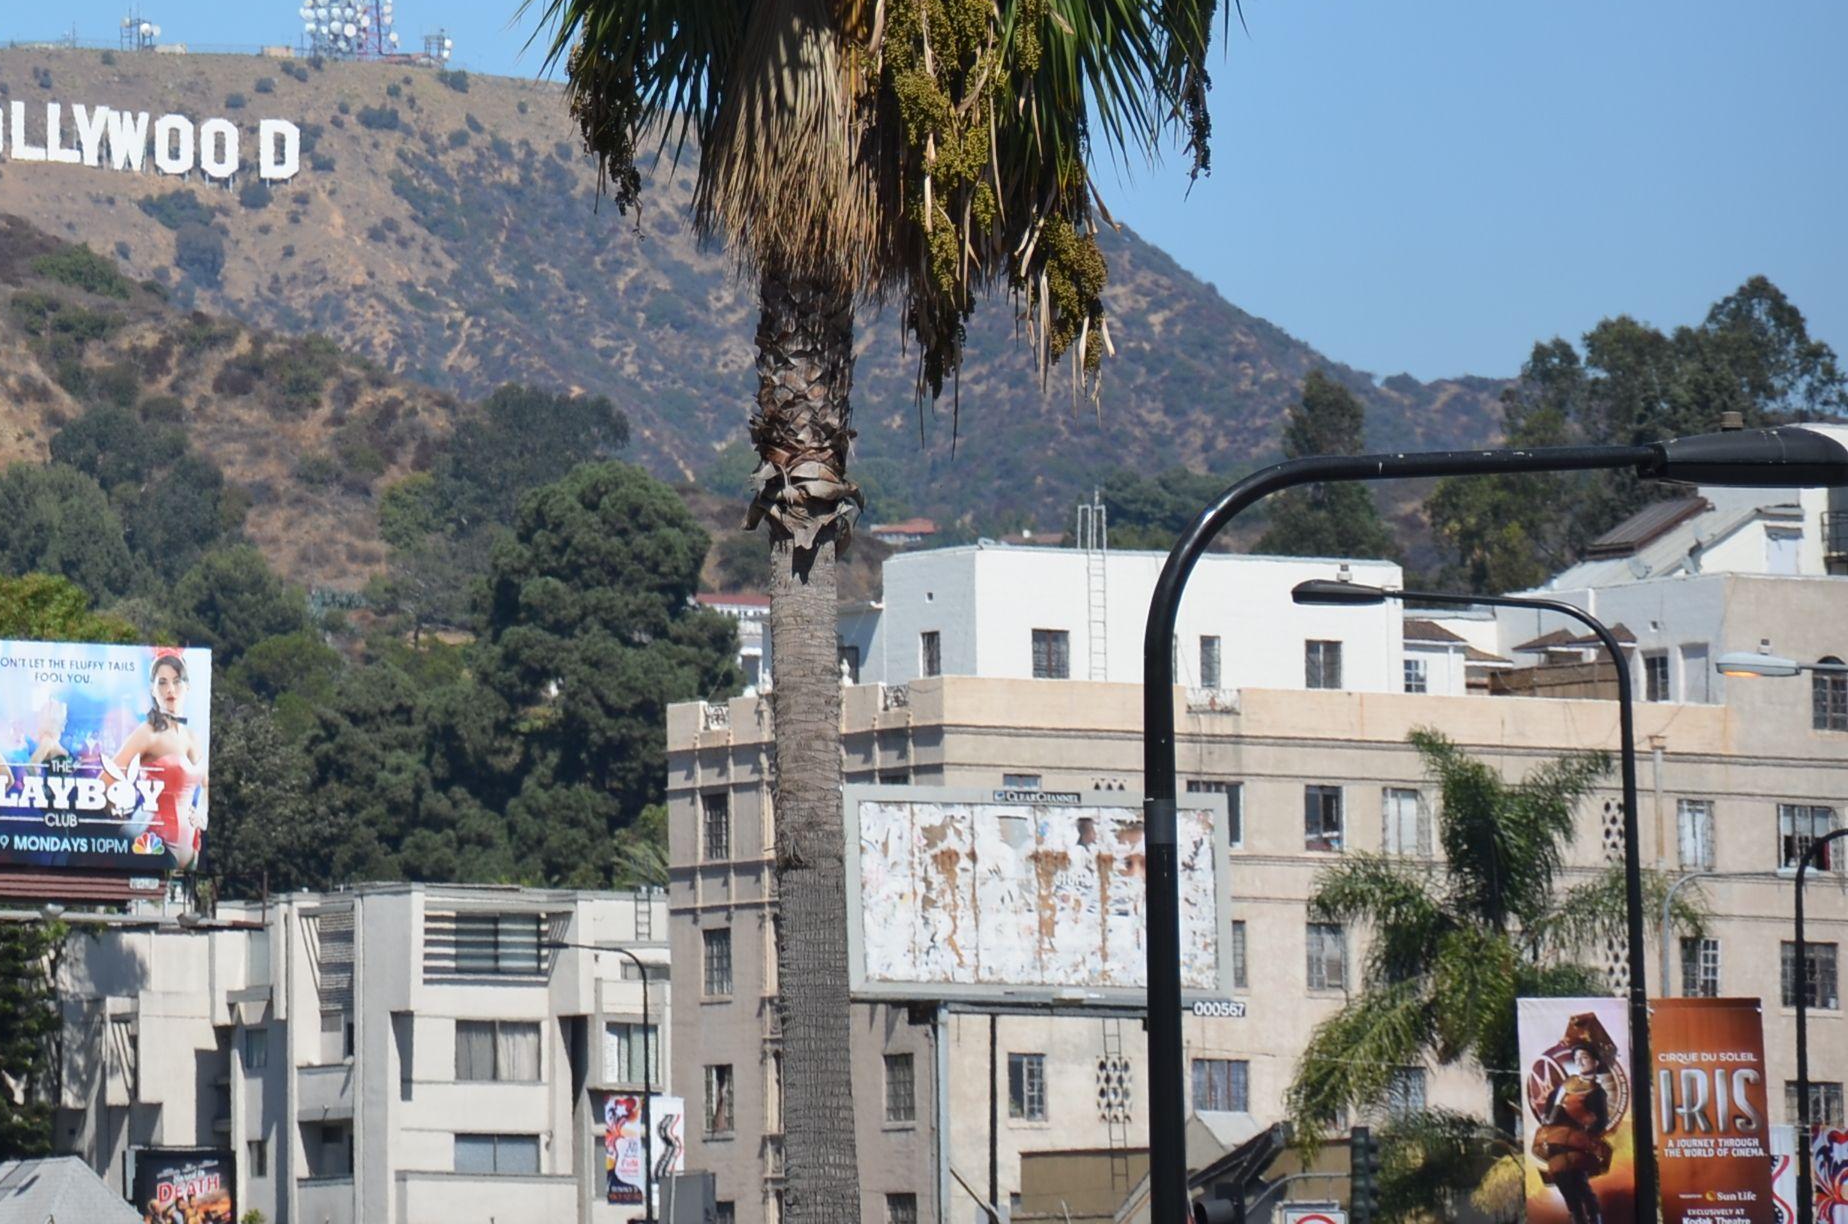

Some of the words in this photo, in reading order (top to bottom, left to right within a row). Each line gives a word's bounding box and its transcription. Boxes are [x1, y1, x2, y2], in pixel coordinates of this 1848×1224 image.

[29, 658, 45, 669] LET
[48, 658, 65, 669] THE
[69, 660, 104, 670] FLUFFY
[108, 661, 135, 671] TAILS
[34, 672, 63, 683] FOOL
[51, 760, 72, 773] THE
[44, 814, 78, 827] CLUB
[13, 836, 89, 853] MONDAYS
[91, 837, 128, 854] 10PM
[1193, 1002, 1245, 1017] 000567
[1658, 1052, 1698, 1064] CIRQUE
[1701, 1052, 1717, 1062] DU
[1719, 1052, 1758, 1062] SOLEIL
[1659, 1068, 1762, 1134] IRIS
[1667, 1138, 1675, 1148] A
[1677, 1138, 1714, 1148] JOURNEY
[1717, 1137, 1760, 1148] THROUGH
[1663, 1148, 1681, 1157] THE
[1683, 1148, 1714, 1157] WORLD
[1716, 1148, 1730, 1157] OF
[156, 1173, 220, 1207] DEATH
[1716, 1191, 1737, 1201] Sun
[1738, 1191, 1757, 1201] Life
